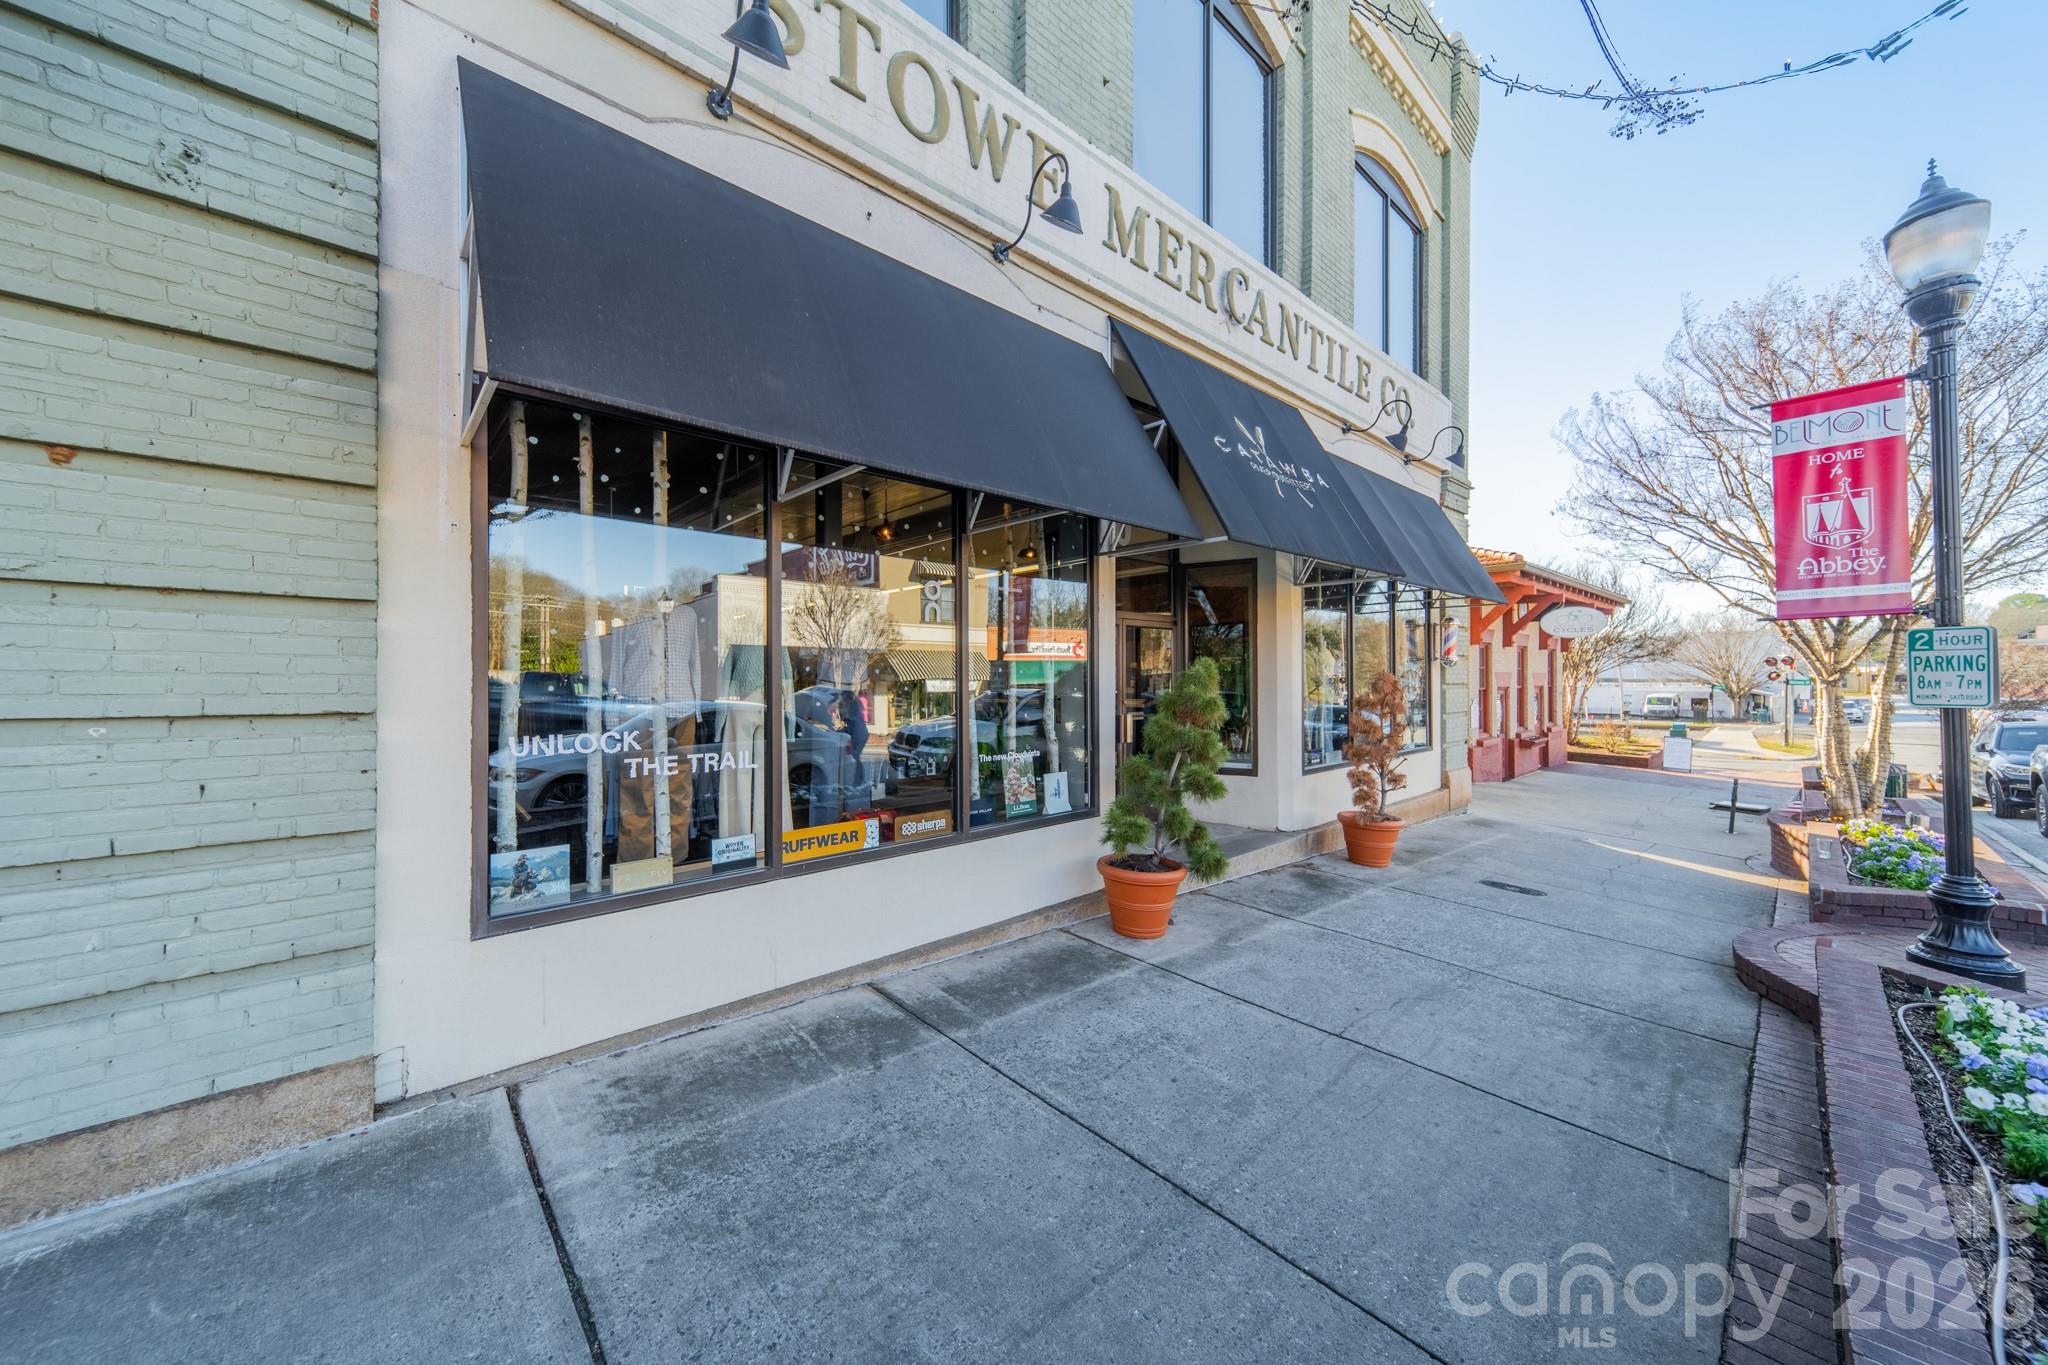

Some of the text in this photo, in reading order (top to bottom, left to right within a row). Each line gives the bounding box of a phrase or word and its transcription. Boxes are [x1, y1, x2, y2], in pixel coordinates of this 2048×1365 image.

[1102, 182, 1373, 403] MERCANTILE
[1807, 447, 1865, 466] HOME
[1848, 546, 1879, 558] The
[1914, 632, 1984, 650] 2 HOUR
[1913, 654, 1986, 673] PARKING
[508, 730, 642, 758] UNLOCK
[623, 750, 759, 779] THE TRAIL
[979, 753, 992, 763] The
[917, 818, 946, 831] sherpa
[782, 829, 860, 854] RUFFWEAR
